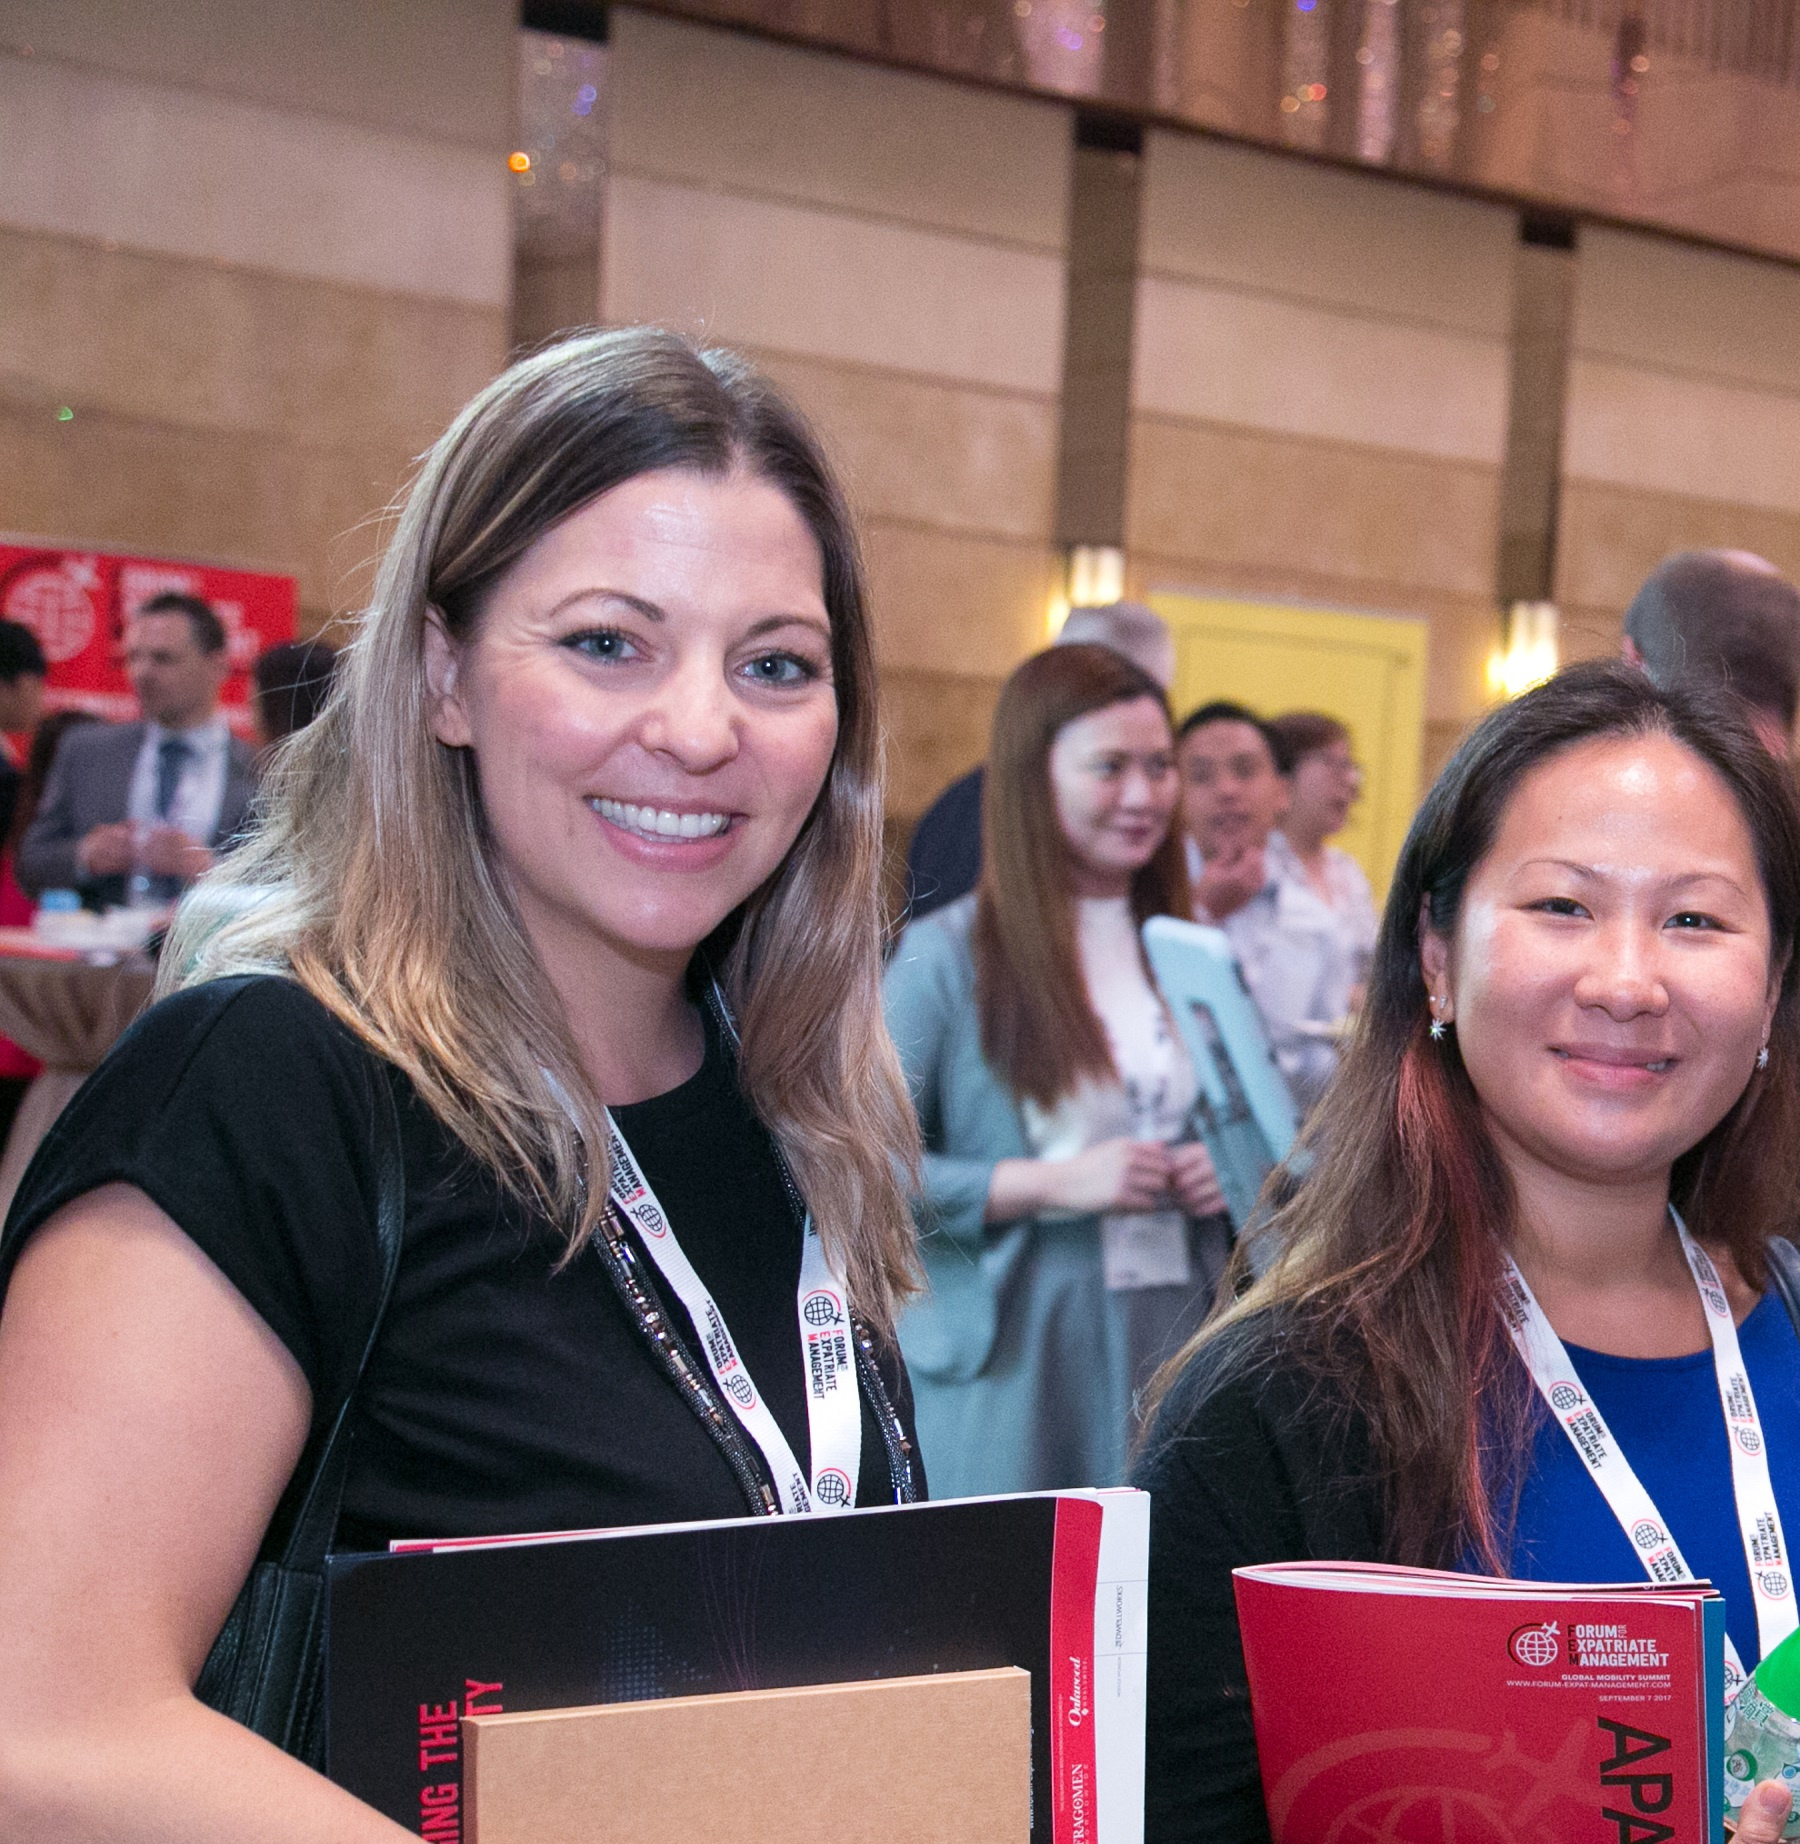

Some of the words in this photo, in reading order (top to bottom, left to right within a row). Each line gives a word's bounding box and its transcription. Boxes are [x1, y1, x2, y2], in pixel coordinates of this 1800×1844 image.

[611, 1131, 646, 1197] MANAGEMEN
[807, 1333, 825, 1399] MANAGEMENT
[820, 1331, 837, 1391] EXPATRIATE
[833, 1329, 847, 1365] FORUM
[1565, 1415, 1602, 1469] MANAGEMENT
[1573, 1411, 1608, 1459] EXPATRIATE
[1583, 1407, 1604, 1435] FORUM
[1664, 1546, 1684, 1576] FORUM
[1567, 1624, 1617, 1639] FORUM
[1567, 1639, 1657, 1653] EXPATRIATE
[1506, 1680, 1671, 1689] WWW.FORUM-EXPAT-MANAGEMENT.COM
[1569, 1653, 1670, 1667] MANAGEMENT
[1068, 1656, 1082, 1727] Oakwood
[418, 1700, 458, 1772] THE
[1072, 1764, 1084, 1844] FRAGOMEN
[1597, 1715, 1675, 1844] APA
[419, 1783, 459, 1844] ING
